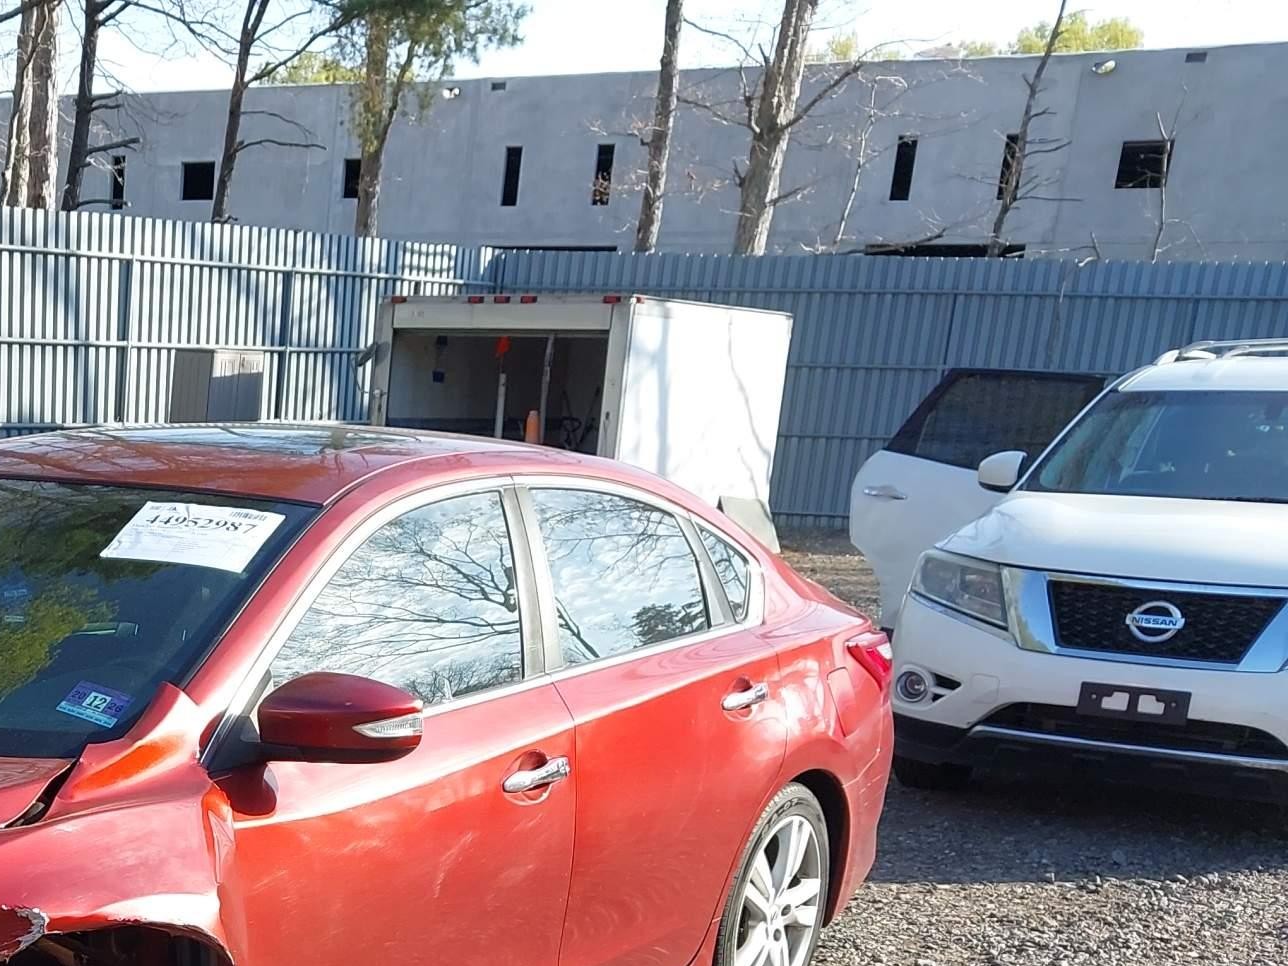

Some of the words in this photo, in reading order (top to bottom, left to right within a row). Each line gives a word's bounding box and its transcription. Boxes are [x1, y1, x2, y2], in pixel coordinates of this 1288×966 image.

[146, 514, 258, 534] 44952987
[1131, 616, 1178, 627] NISSAN
[87, 695, 107, 710] 12
